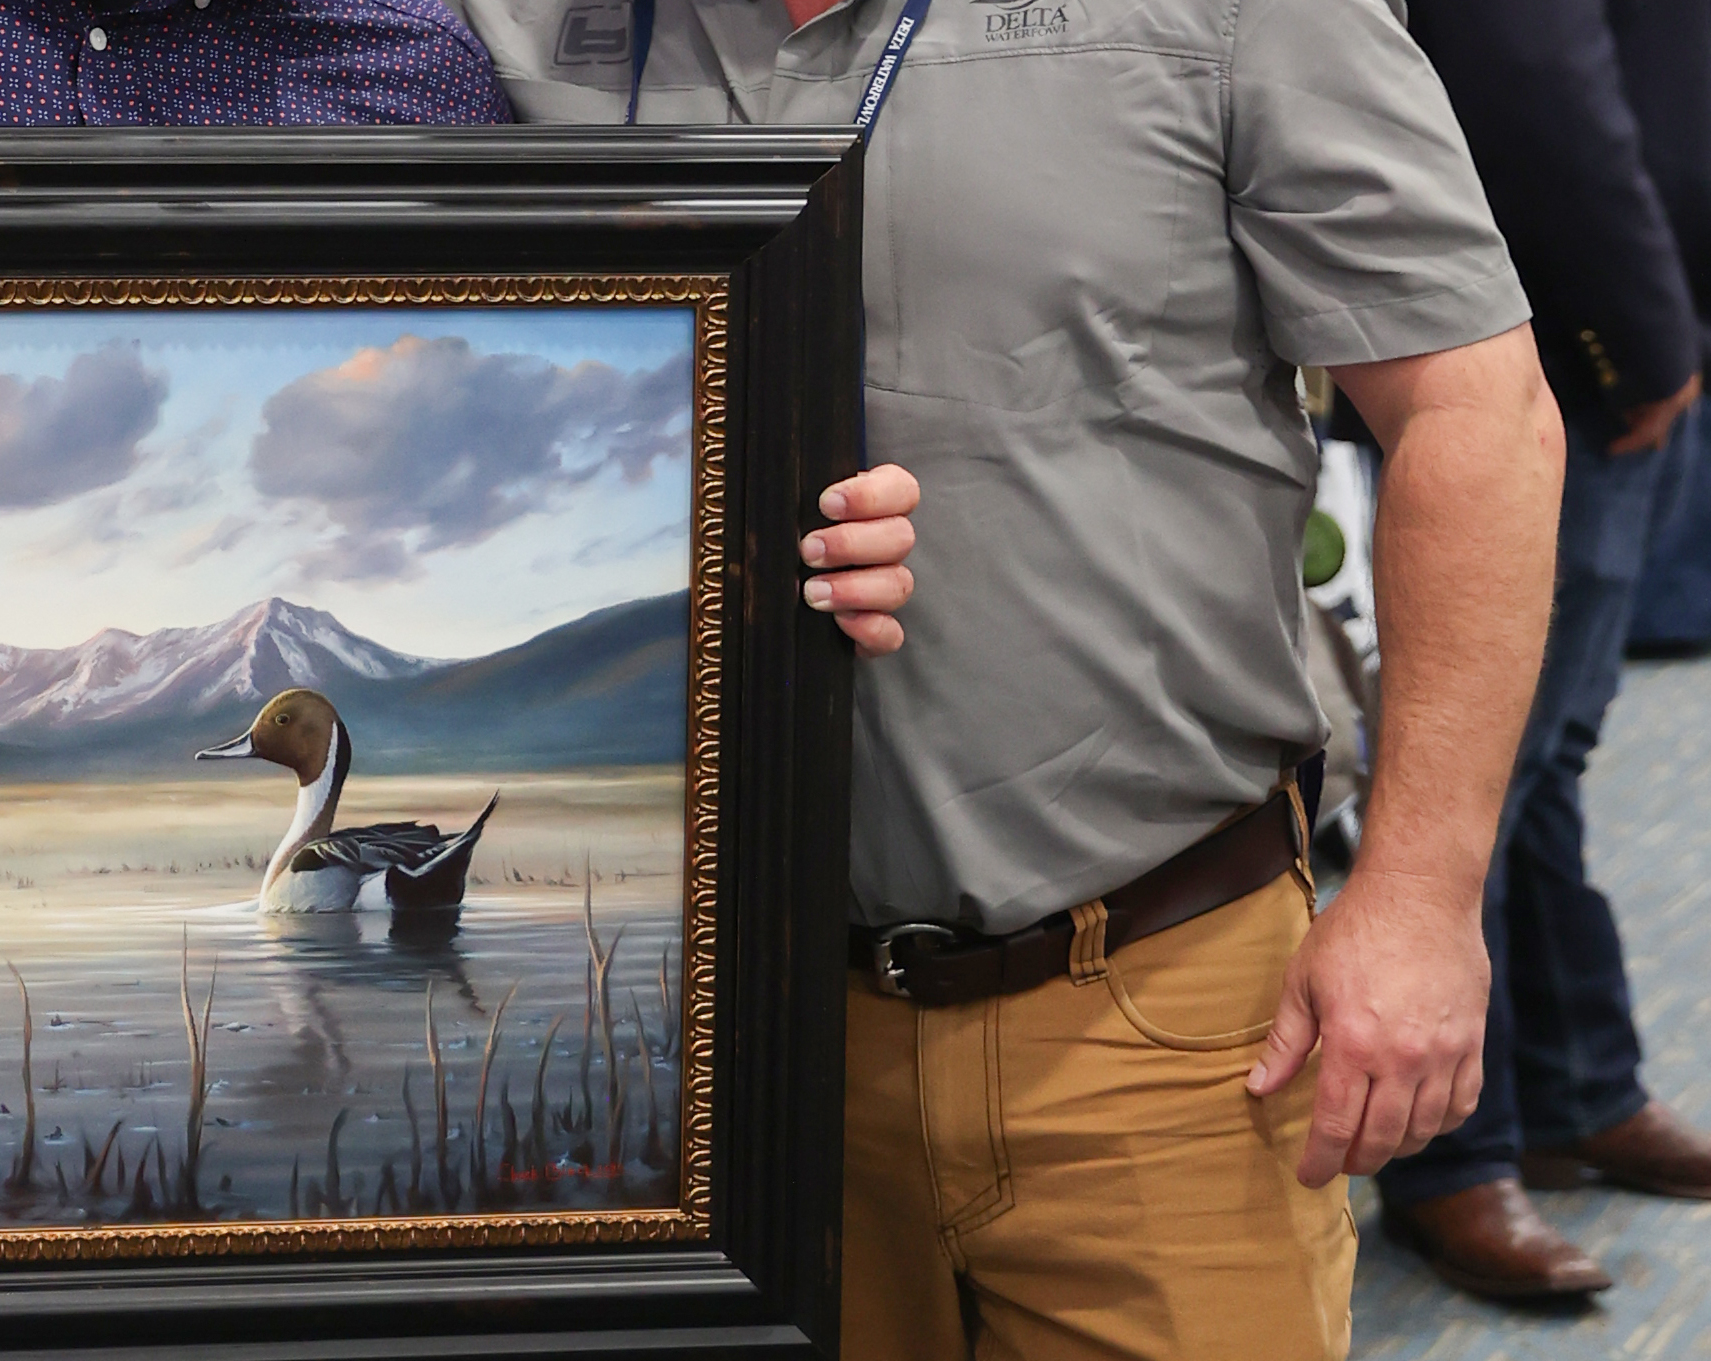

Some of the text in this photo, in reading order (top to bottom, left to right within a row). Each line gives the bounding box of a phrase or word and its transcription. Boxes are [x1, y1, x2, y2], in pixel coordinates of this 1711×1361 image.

[986, 7, 1069, 33] DELTA
[856, 16, 915, 126] DELTA WATERFOWL
